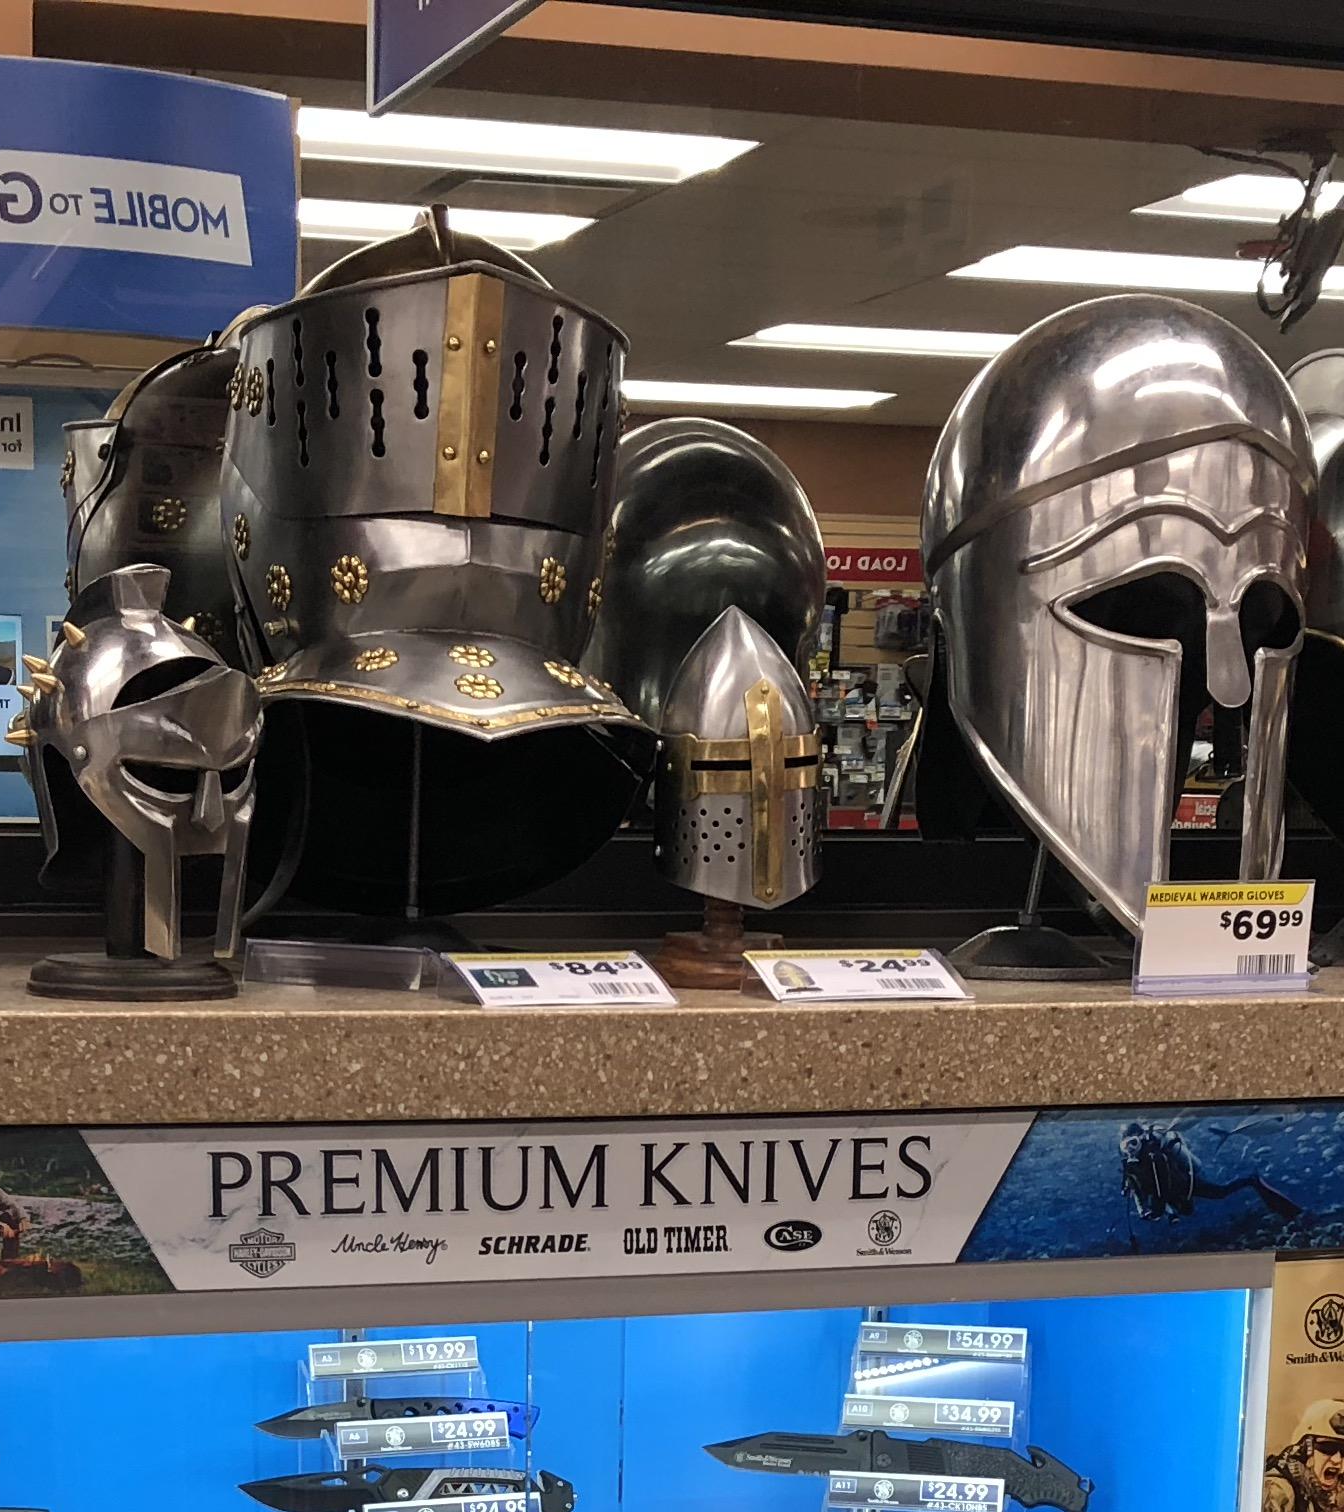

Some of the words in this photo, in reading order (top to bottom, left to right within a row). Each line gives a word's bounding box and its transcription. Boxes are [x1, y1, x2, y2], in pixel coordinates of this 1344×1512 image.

[1150, 892, 1196, 902] MEDIEVAL
[1200, 891, 1244, 901] WARRIOR
[1247, 890, 1284, 900] GLOVES
[207, 1143, 611, 1220] PREMIUM
[640, 1134, 934, 1209] KNIVES
[332, 1233, 389, 1254] Uncle
[390, 1232, 441, 1264] Henry
[478, 1233, 588, 1255] SCHRADE
[623, 1227, 658, 1255] OLD
[664, 1225, 728, 1253] TIMER
[956, 1331, 1014, 1350] $54.99
[408, 1342, 467, 1361] $19.99
[942, 1403, 1002, 1424] $34.99
[438, 1419, 496, 1440] $24.99
[928, 1481, 989, 1501] $24.99
